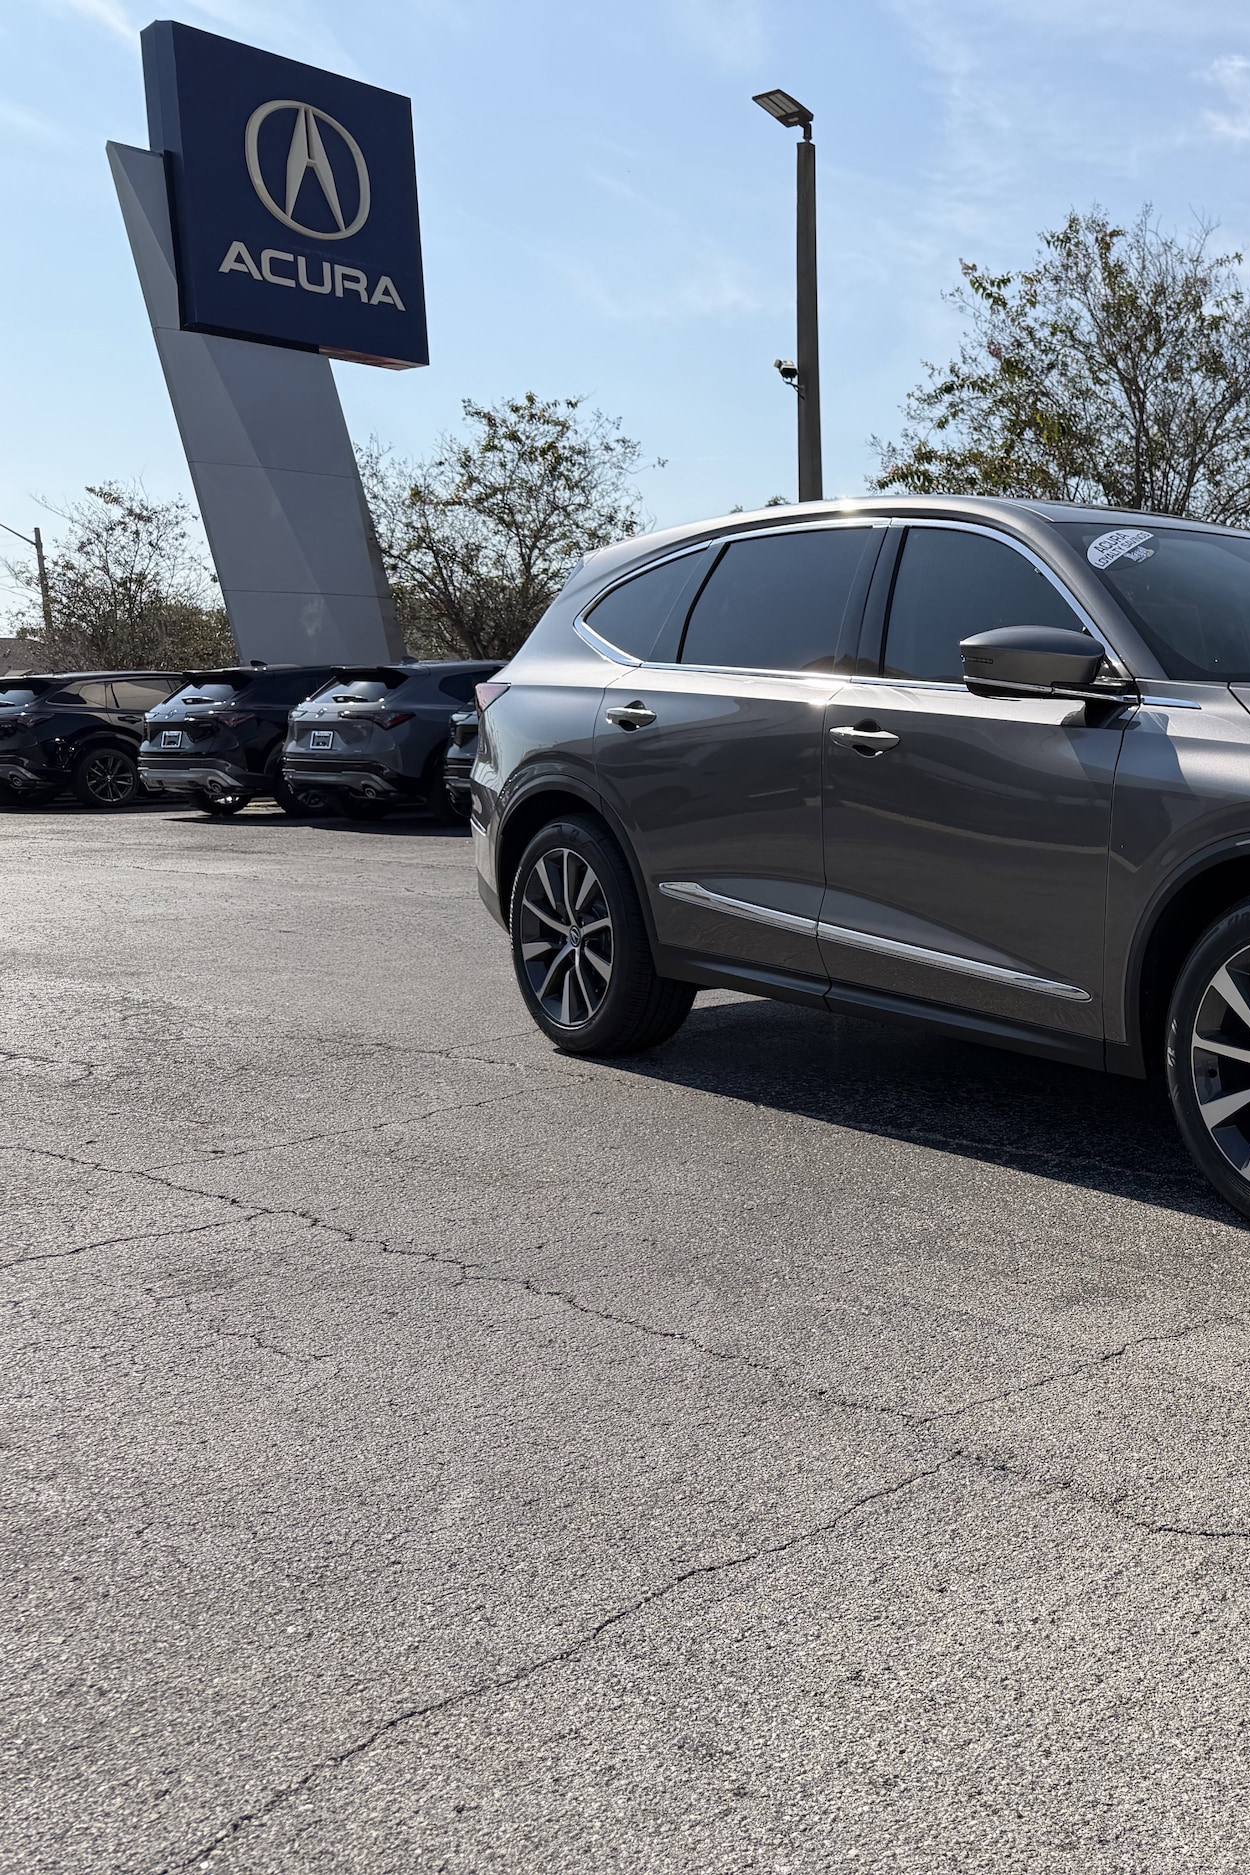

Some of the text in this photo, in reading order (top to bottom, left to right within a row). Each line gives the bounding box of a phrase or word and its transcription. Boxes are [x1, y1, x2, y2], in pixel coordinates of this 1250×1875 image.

[218, 240, 406, 312] ACURA
[1093, 532, 1130, 554] ACURA
[1095, 532, 1150, 567] LOYALTY SAVINGS
